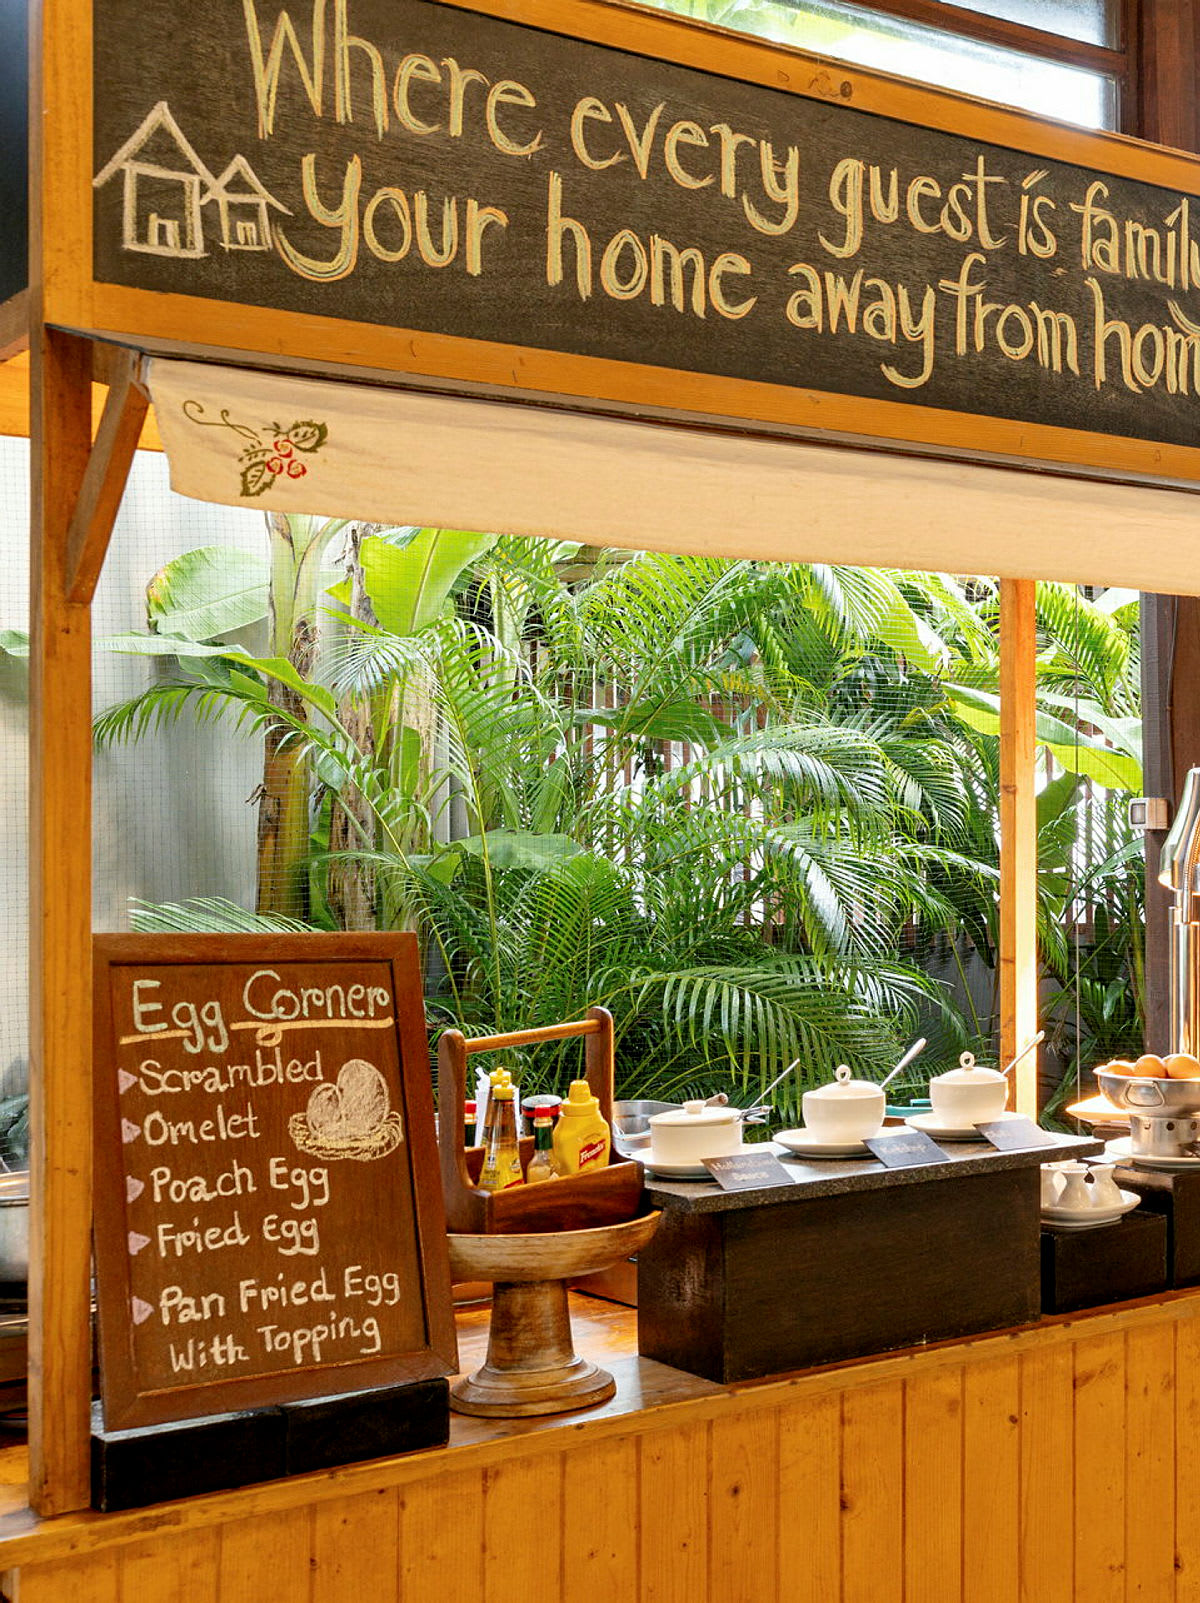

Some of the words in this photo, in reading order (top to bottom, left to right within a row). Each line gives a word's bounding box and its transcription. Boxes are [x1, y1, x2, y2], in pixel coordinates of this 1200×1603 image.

[242, 0, 546, 159] Where
[571, 94, 799, 237] every
[818, 154, 1008, 260] guest
[1017, 168, 1058, 259] is
[272, 152, 508, 283] your
[546, 170, 757, 320] home
[785, 262, 936, 389] away
[939, 252, 1080, 378] from
[131, 978, 230, 1054] Egg
[242, 968, 391, 1023] Corner
[137, 1049, 324, 1097] Scrambled
[143, 1102, 261, 1147] Omelet
[150, 1158, 258, 1204] Poach
[268, 1156, 331, 1211] Egg
[156, 1211, 250, 1260] Fried
[262, 1213, 321, 1257] Egg
[158, 1284, 226, 1327] Pan
[239, 1265, 337, 1309] Fried
[342, 1264, 402, 1307] Egg
[169, 1329, 250, 1373] With
[257, 1310, 383, 1365] Topping
